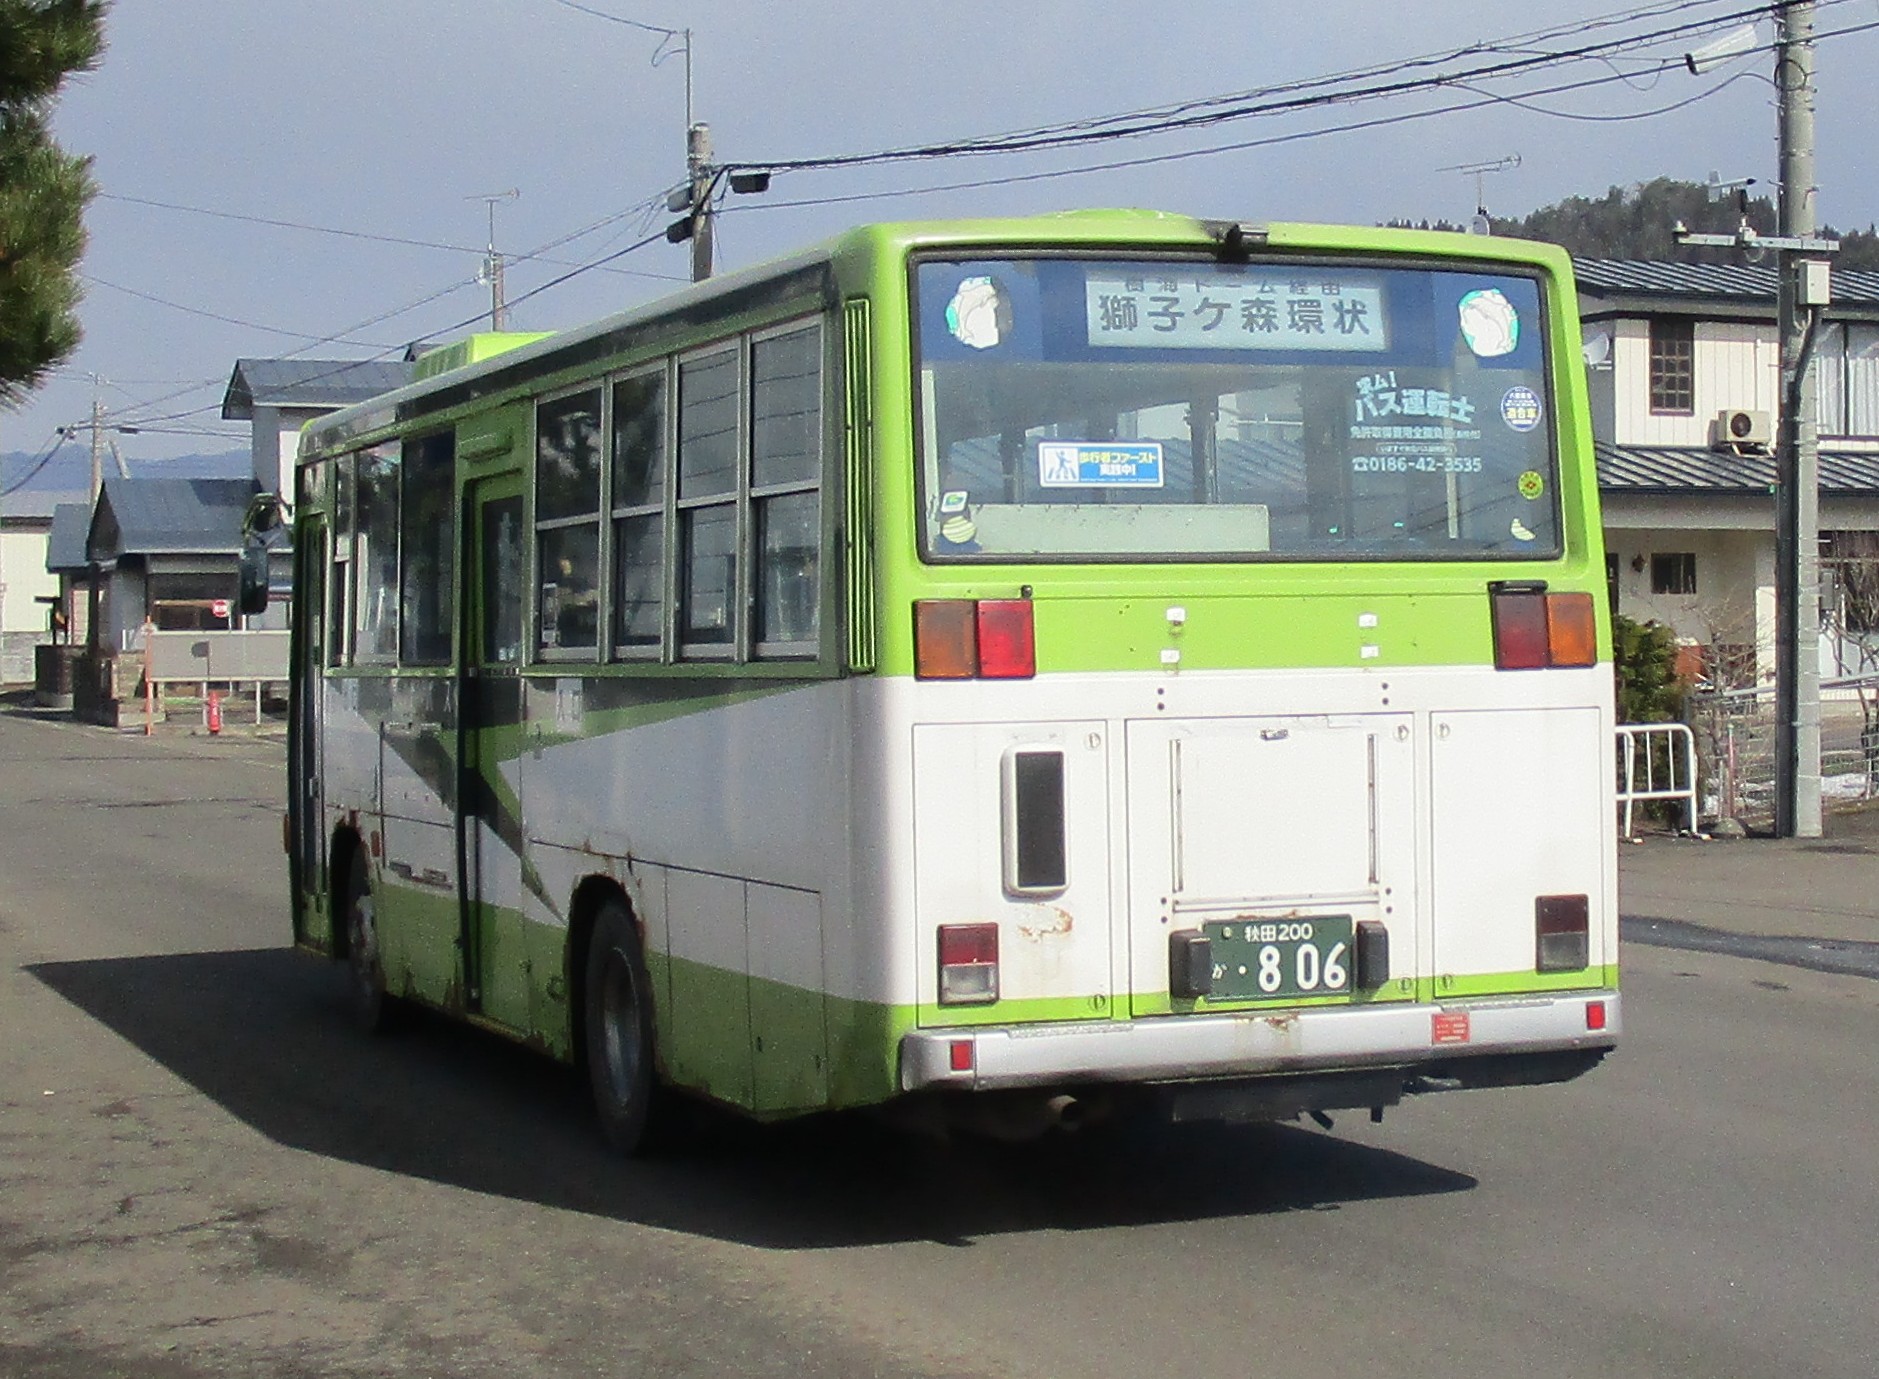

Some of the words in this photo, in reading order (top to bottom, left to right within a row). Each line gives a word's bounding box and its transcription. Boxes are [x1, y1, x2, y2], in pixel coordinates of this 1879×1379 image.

[1355, 388, 1475, 423] バス運転士
[1079, 452, 1156, 463] 歩行者ファースト
[1370, 457, 1482, 471] 0186-42-3535
[1244, 923, 1313, 942] 秋田200
